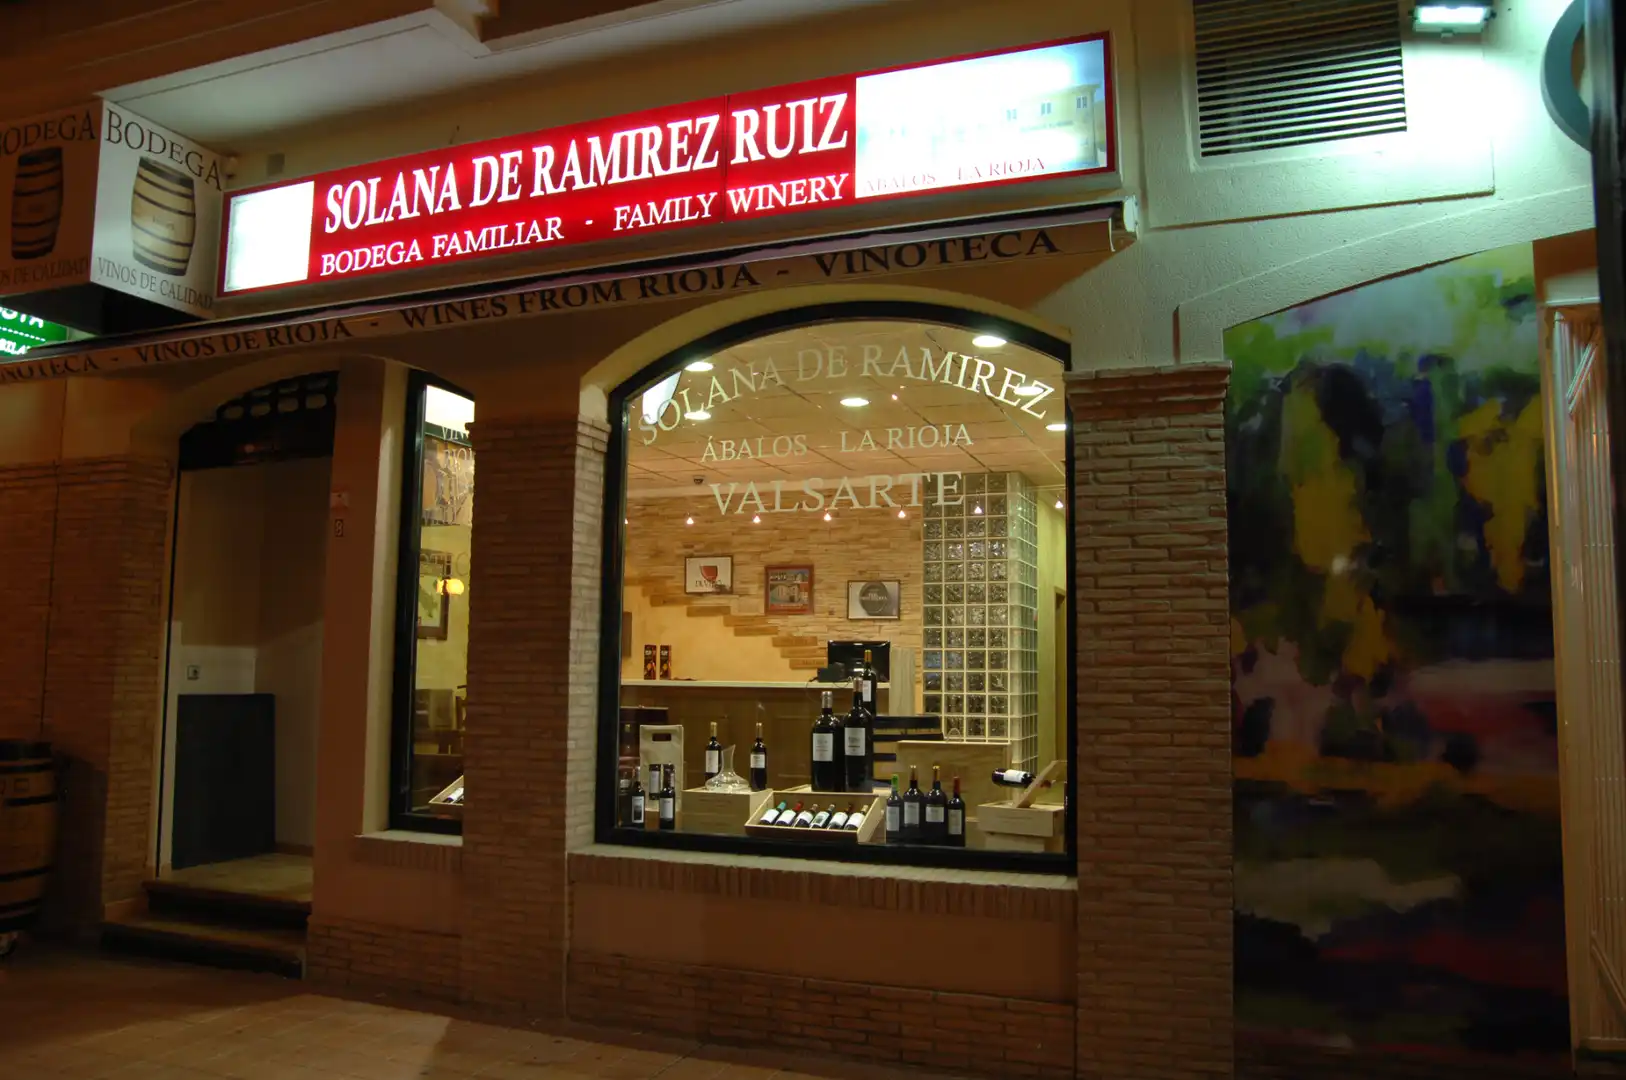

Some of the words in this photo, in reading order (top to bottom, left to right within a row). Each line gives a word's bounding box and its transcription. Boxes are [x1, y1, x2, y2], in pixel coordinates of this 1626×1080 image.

[0, 111, 96, 156] ODEGA
[105, 108, 222, 191] BODEGA
[325, 162, 462, 233] SOLANA
[469, 150, 522, 208] DE
[530, 114, 720, 198] RAMIREZ
[730, 93, 848, 165] RUIZ
[957, 165, 982, 181] LA
[989, 157, 1046, 177] RIOJA
[320, 238, 423, 276] BODEGA
[431, 216, 564, 258] FAMILIAR
[613, 192, 717, 231] FAMILY
[727, 173, 849, 215] WINERY
[97, 256, 137, 285] VINOS
[140, 272, 157, 292] DE
[160, 279, 213, 309] CALIDAD
[135, 334, 216, 363] VINOS
[222, 330, 260, 353] DE
[266, 317, 353, 348] RIOJA
[400, 296, 509, 329] WINES
[517, 276, 625, 315] FROM
[637, 262, 762, 299] RIOJA
[811, 229, 1061, 277] VINOTECA
[639, 356, 785, 446] SOLANA
[796, 345, 848, 383] DE
[860, 344, 1056, 420] RAMIREZ
[700, 435, 808, 463] ÁBALOS
[839, 428, 876, 453] LA
[887, 423, 974, 452] RIOJA
[708, 470, 965, 517] VALSARTE
